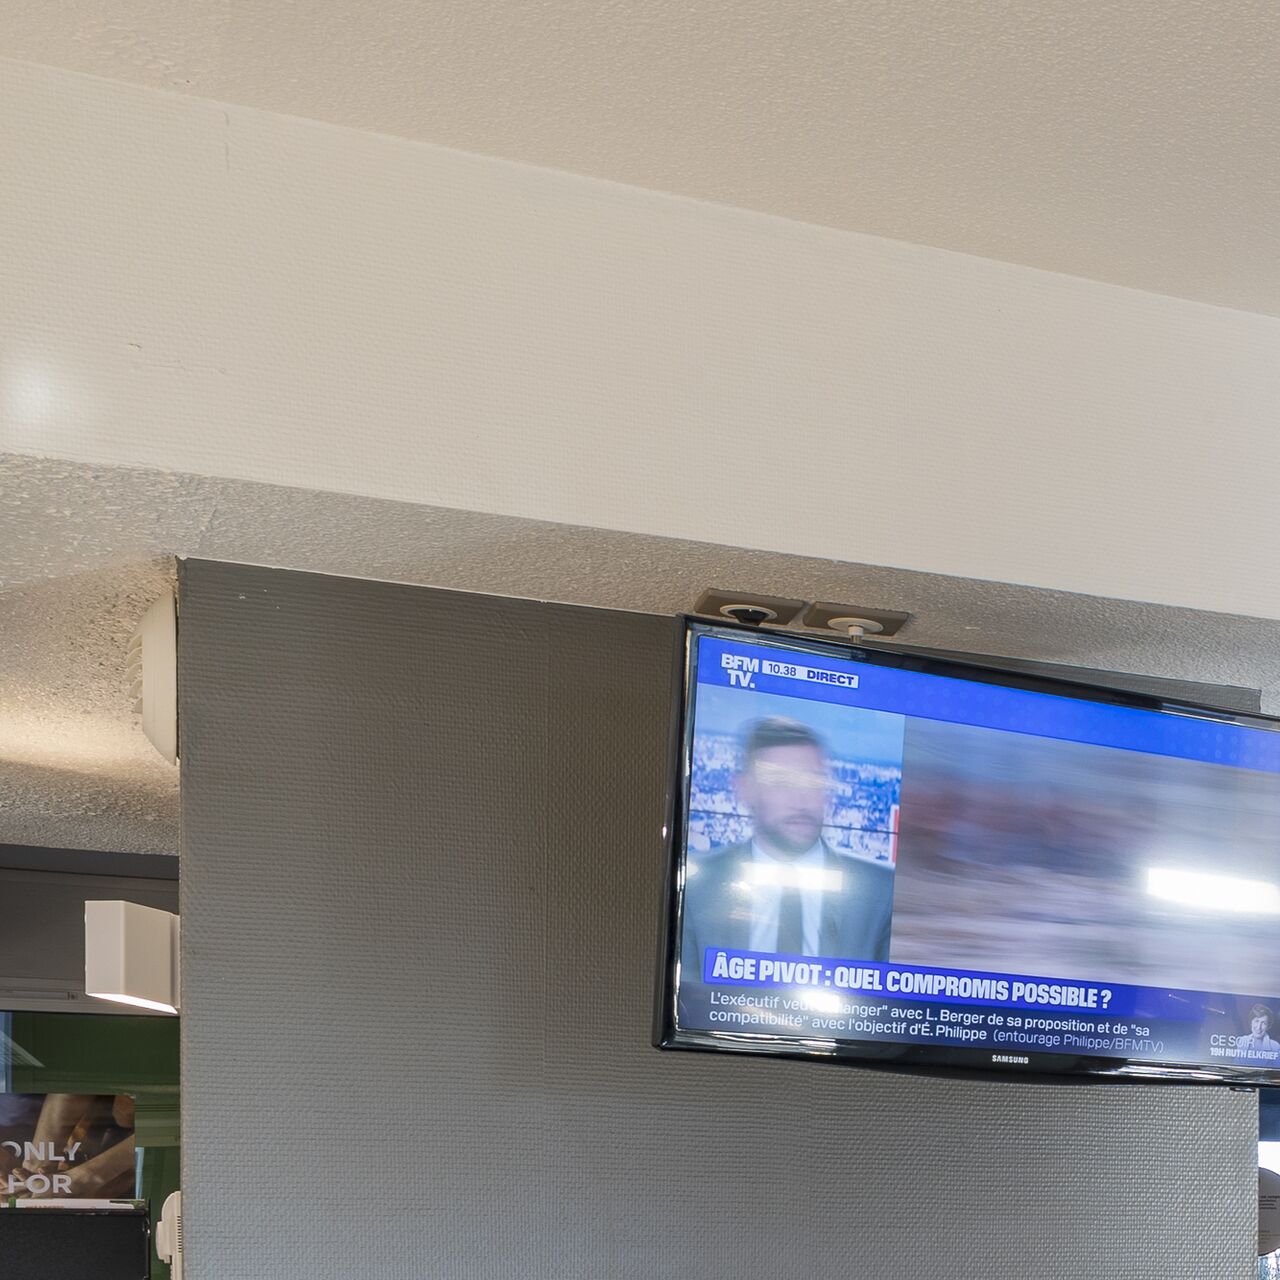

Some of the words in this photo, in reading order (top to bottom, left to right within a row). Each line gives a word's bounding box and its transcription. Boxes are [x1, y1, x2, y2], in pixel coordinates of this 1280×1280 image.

[721, 653, 759, 673] BFM
[806, 669, 854, 686] DIRECT
[712, 952, 756, 981] ÂGE
[759, 960, 822, 986] PIVOT
[825, 970, 831, 986] :
[834, 967, 883, 991] QUEL
[886, 971, 1009, 1002] COMPROMIS
[1012, 981, 1098, 1008] POSSIBLE
[1101, 989, 1112, 1009] ?
[710, 992, 780, 1009] L'exécutif
[783, 999, 808, 1011] veu
[891, 1009, 923, 1020] avec
[926, 1008, 938, 1021] L.
[940, 1010, 986, 1026] Berger
[987, 1013, 1003, 1025] de
[1006, 1017, 1022, 1027] sa
[1025, 1017, 1094, 1033] proposition
[1097, 1023, 1110, 1034] et
[1113, 1022, 1128, 1035] de
[1131, 1024, 1150, 1037] "sa
[709, 1010, 809, 1028] compatibilité"
[812, 1018, 845, 1030] avec
[848, 1020, 908, 1035] l'objectif
[936, 1024, 987, 1041] Philippe
[993, 1028, 1060, 1047] (entourage
[1064, 1033, 1164, 1054] Philippe/BFMTV)
[1210, 1034, 1226, 1046] CE
[1228, 1036, 1255, 1048] SOIR
[992, 1054, 1029, 1064] SAMSUNG
[1210, 1047, 1225, 1057] 19H
[1225, 1048, 1247, 1058] RUTH
[1248, 1050, 1279, 1060] ELKRIEF
